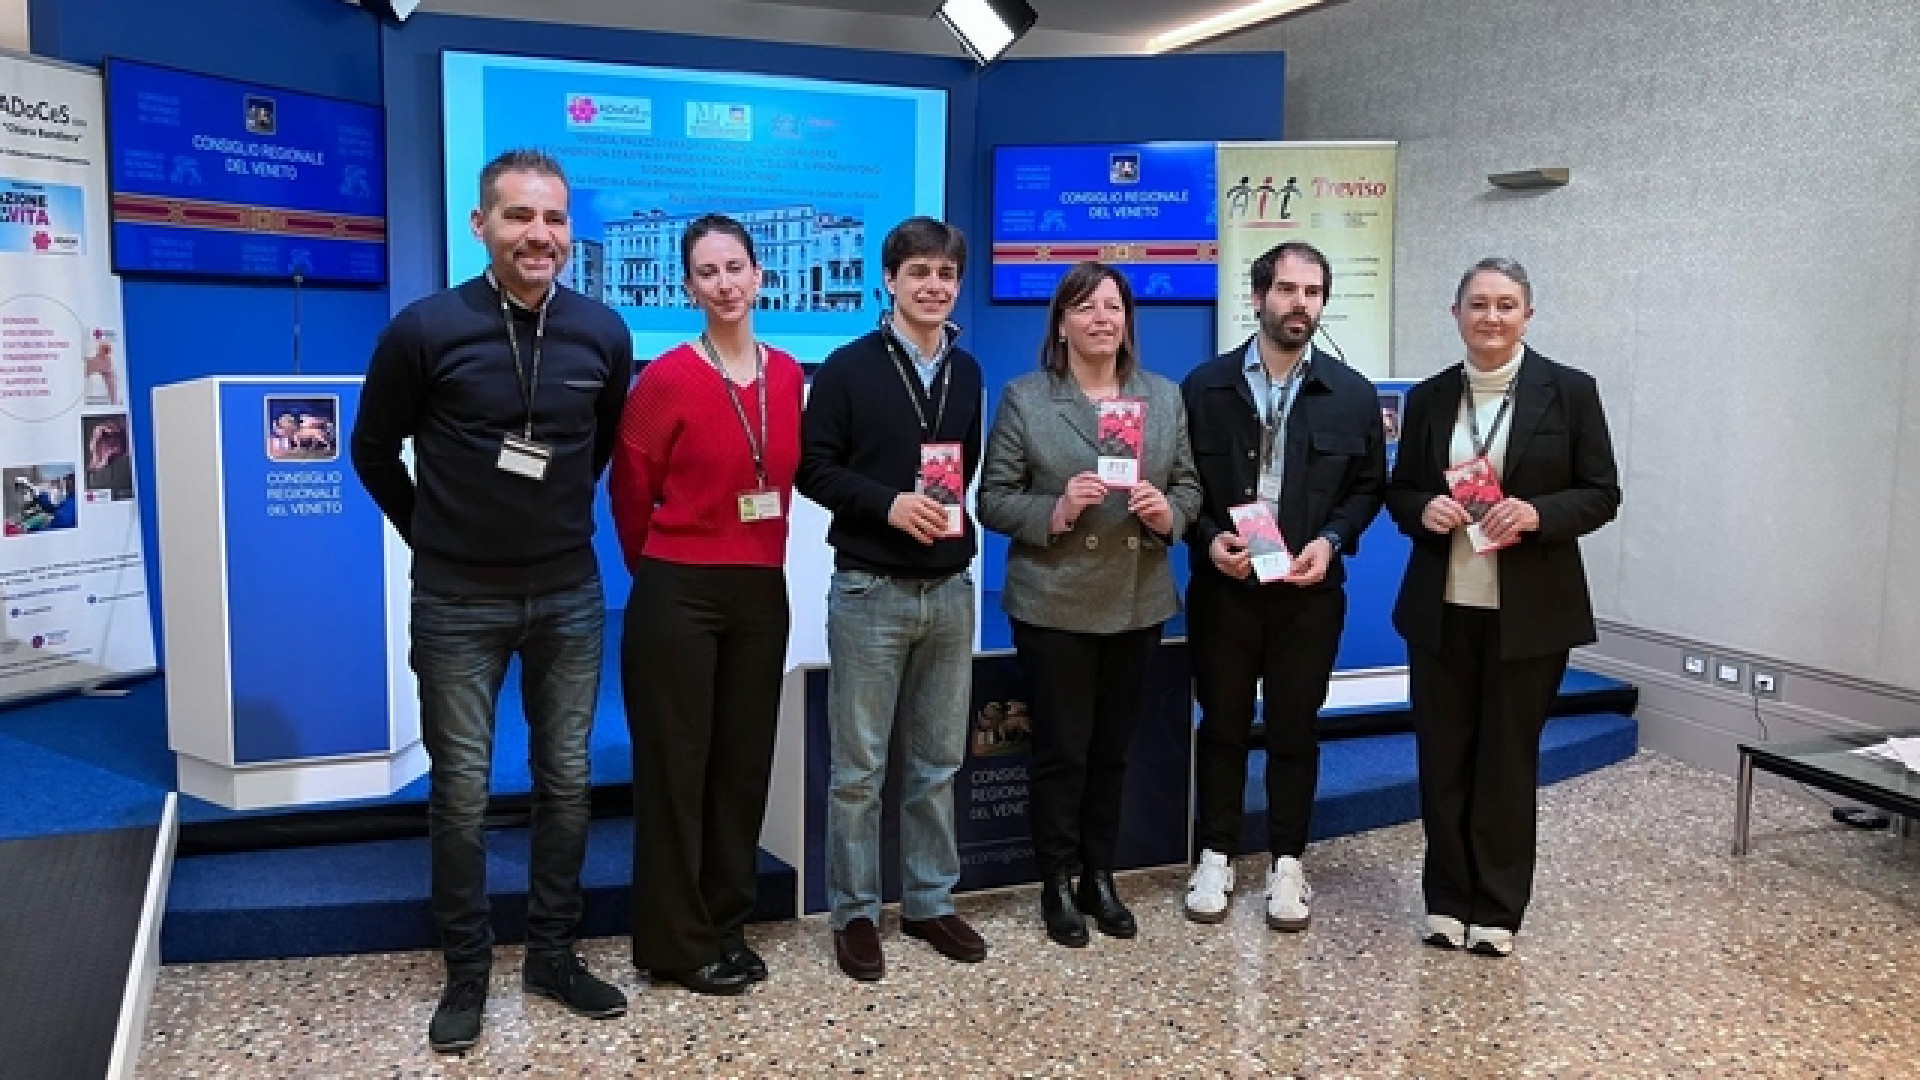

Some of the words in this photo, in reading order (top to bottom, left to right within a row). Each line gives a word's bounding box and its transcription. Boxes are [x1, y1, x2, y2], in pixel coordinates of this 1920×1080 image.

[191, 134, 259, 157] CONSIGLIO
[260, 143, 325, 166] REGIONALE
[225, 157, 250, 175] DEL
[251, 161, 298, 181] VENETO
[1311, 176, 1388, 199] Treviso
[1059, 190, 1122, 205] CONSIGLIO
[1124, 189, 1189, 204] REGIONALE
[9, 207, 50, 226] VITA
[1089, 206, 1111, 220] DEL
[1113, 206, 1160, 219] VENETO
[266, 471, 343, 484] CONSIGLIO
[266, 486, 343, 501] REGIONALE
[267, 503, 289, 517] DEL
[290, 501, 343, 516] VENETO
[970, 765, 1030, 785] CONSIGL
[971, 784, 1029, 802] REGIONA
